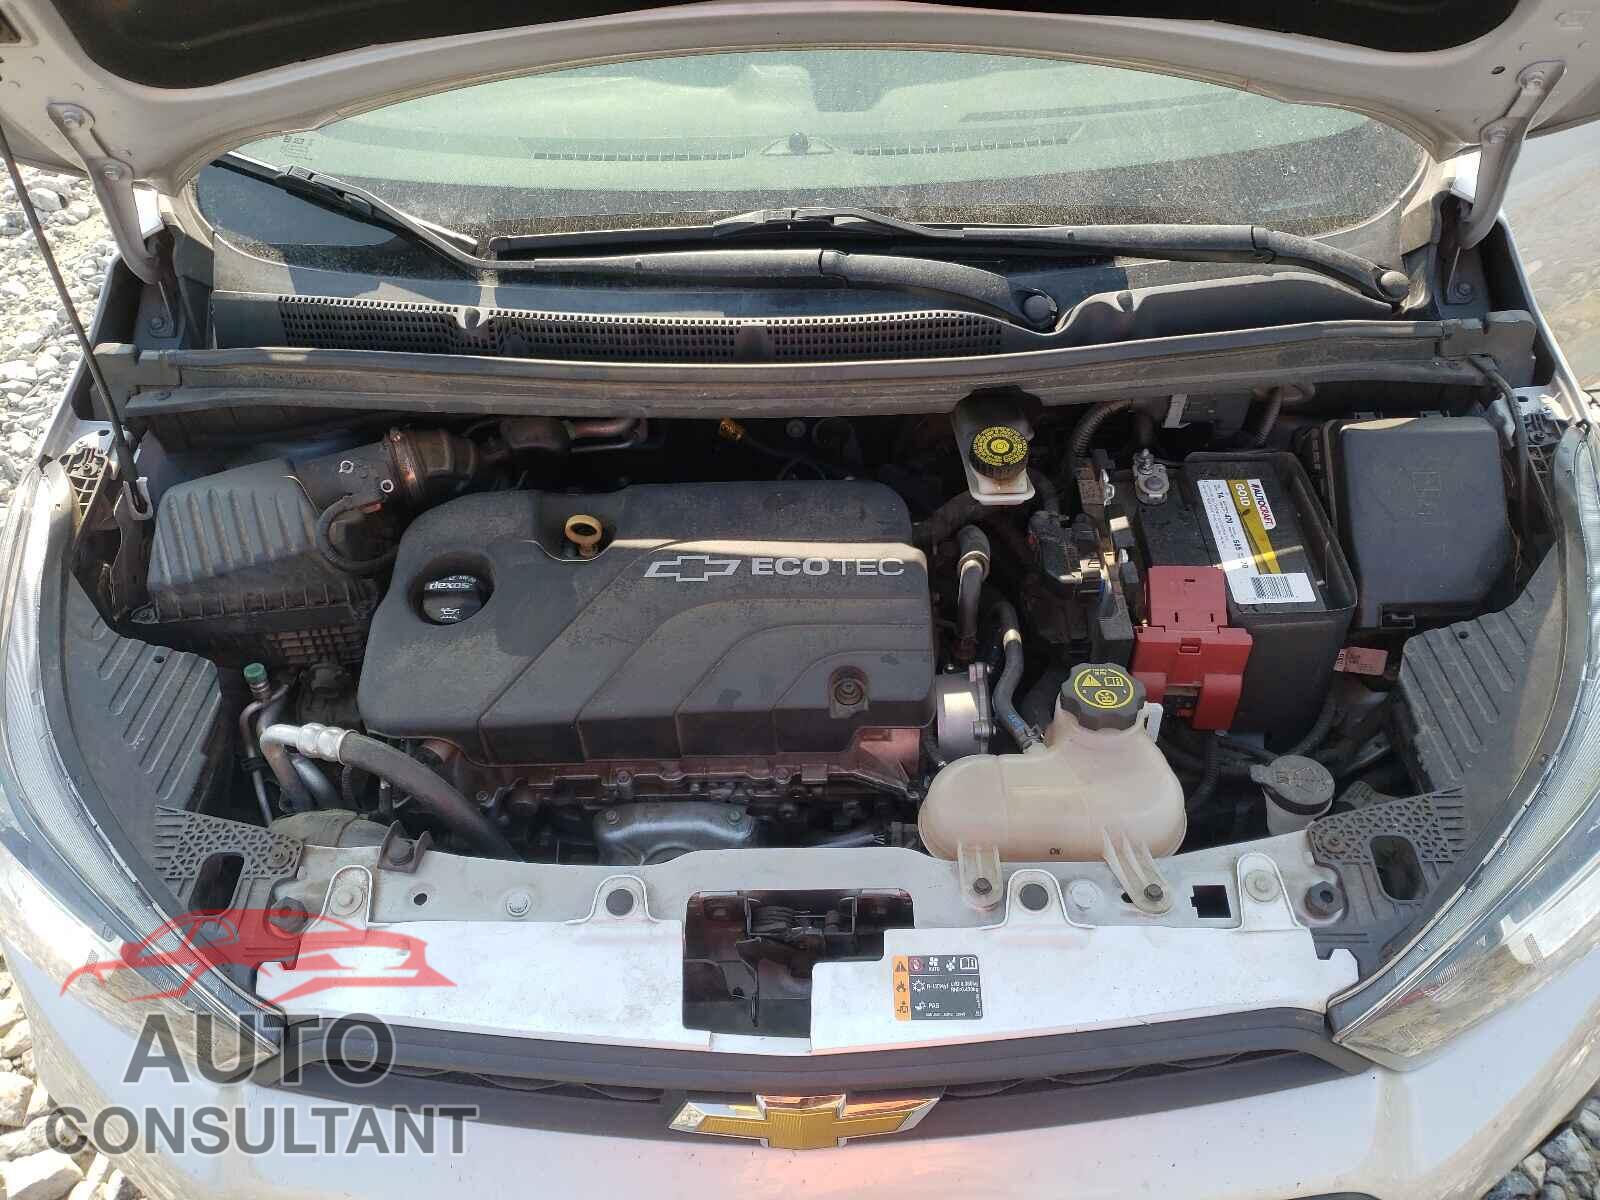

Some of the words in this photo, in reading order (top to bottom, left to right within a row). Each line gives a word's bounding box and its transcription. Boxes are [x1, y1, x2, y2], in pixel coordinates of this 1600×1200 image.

[1236, 484, 1251, 506] GOLD
[1254, 487, 1274, 527] AUTOCRAFT
[751, 557, 905, 576] ECOTEC
[429, 581, 471, 590] dexos
